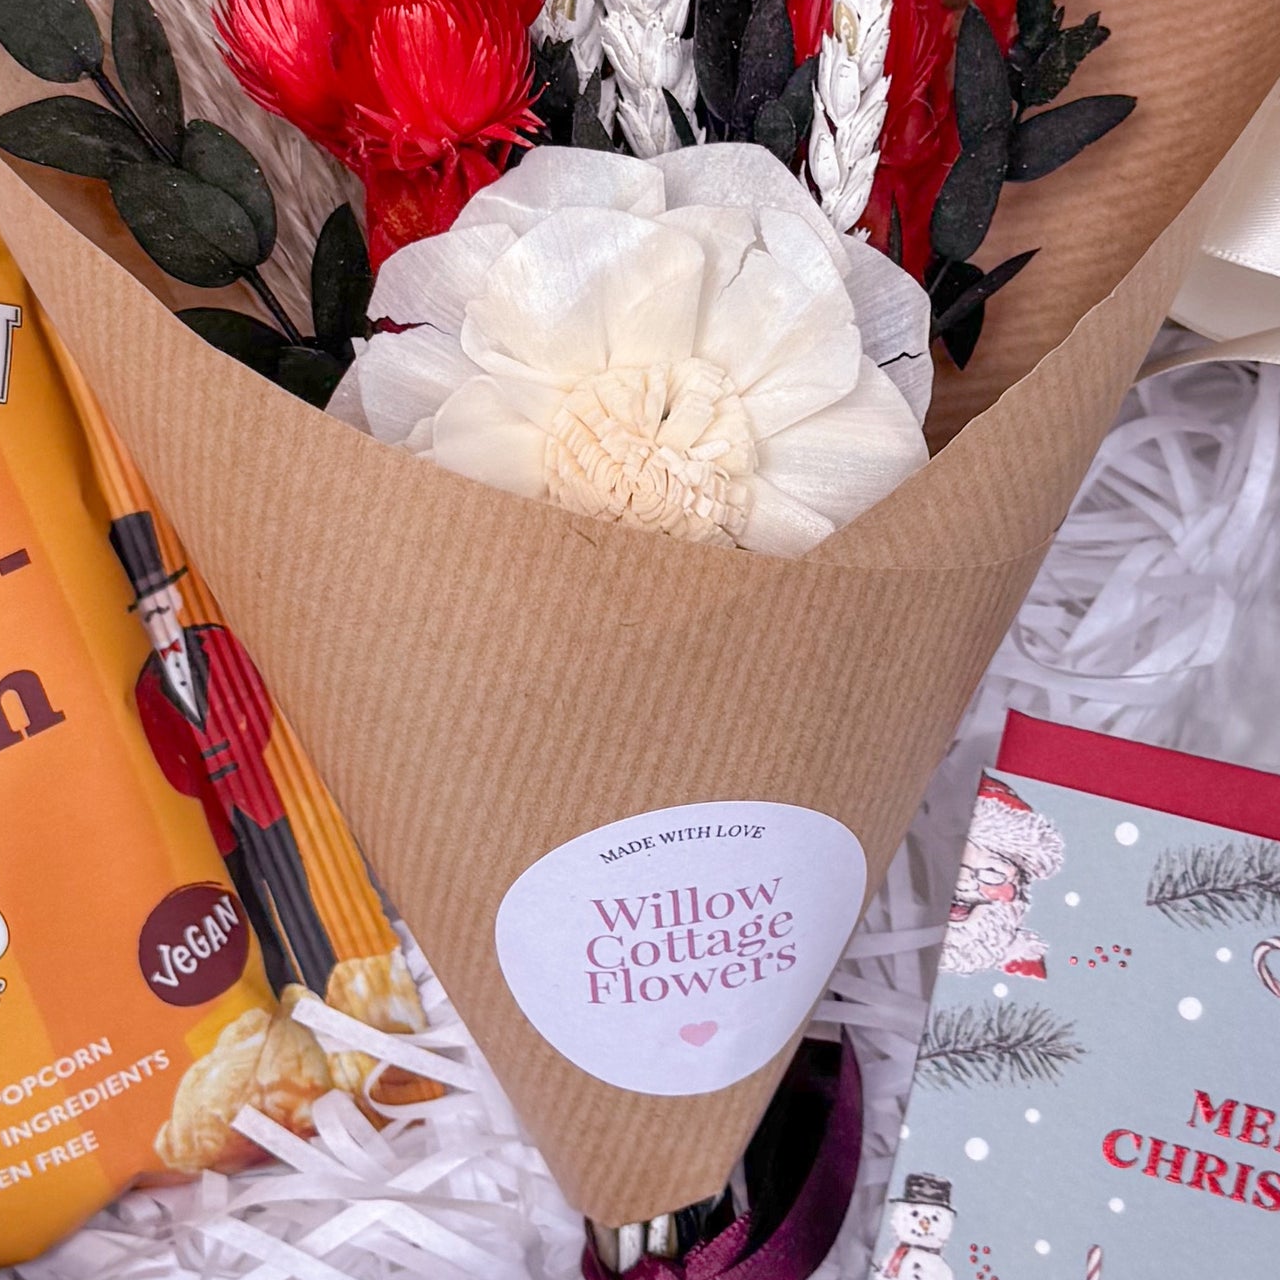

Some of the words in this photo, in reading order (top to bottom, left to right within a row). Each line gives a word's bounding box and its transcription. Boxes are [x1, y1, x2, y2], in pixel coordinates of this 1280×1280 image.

[598, 835, 656, 865] MADE
[658, 825, 711, 846] WITH
[715, 823, 767, 840] LOVE
[589, 876, 784, 934] Willow
[585, 910, 795, 972] Cottage
[584, 941, 797, 1005] Flowers
[0, 1048, 171, 1149] INGREDIENTS
[35, 1129, 100, 1174] FREE
